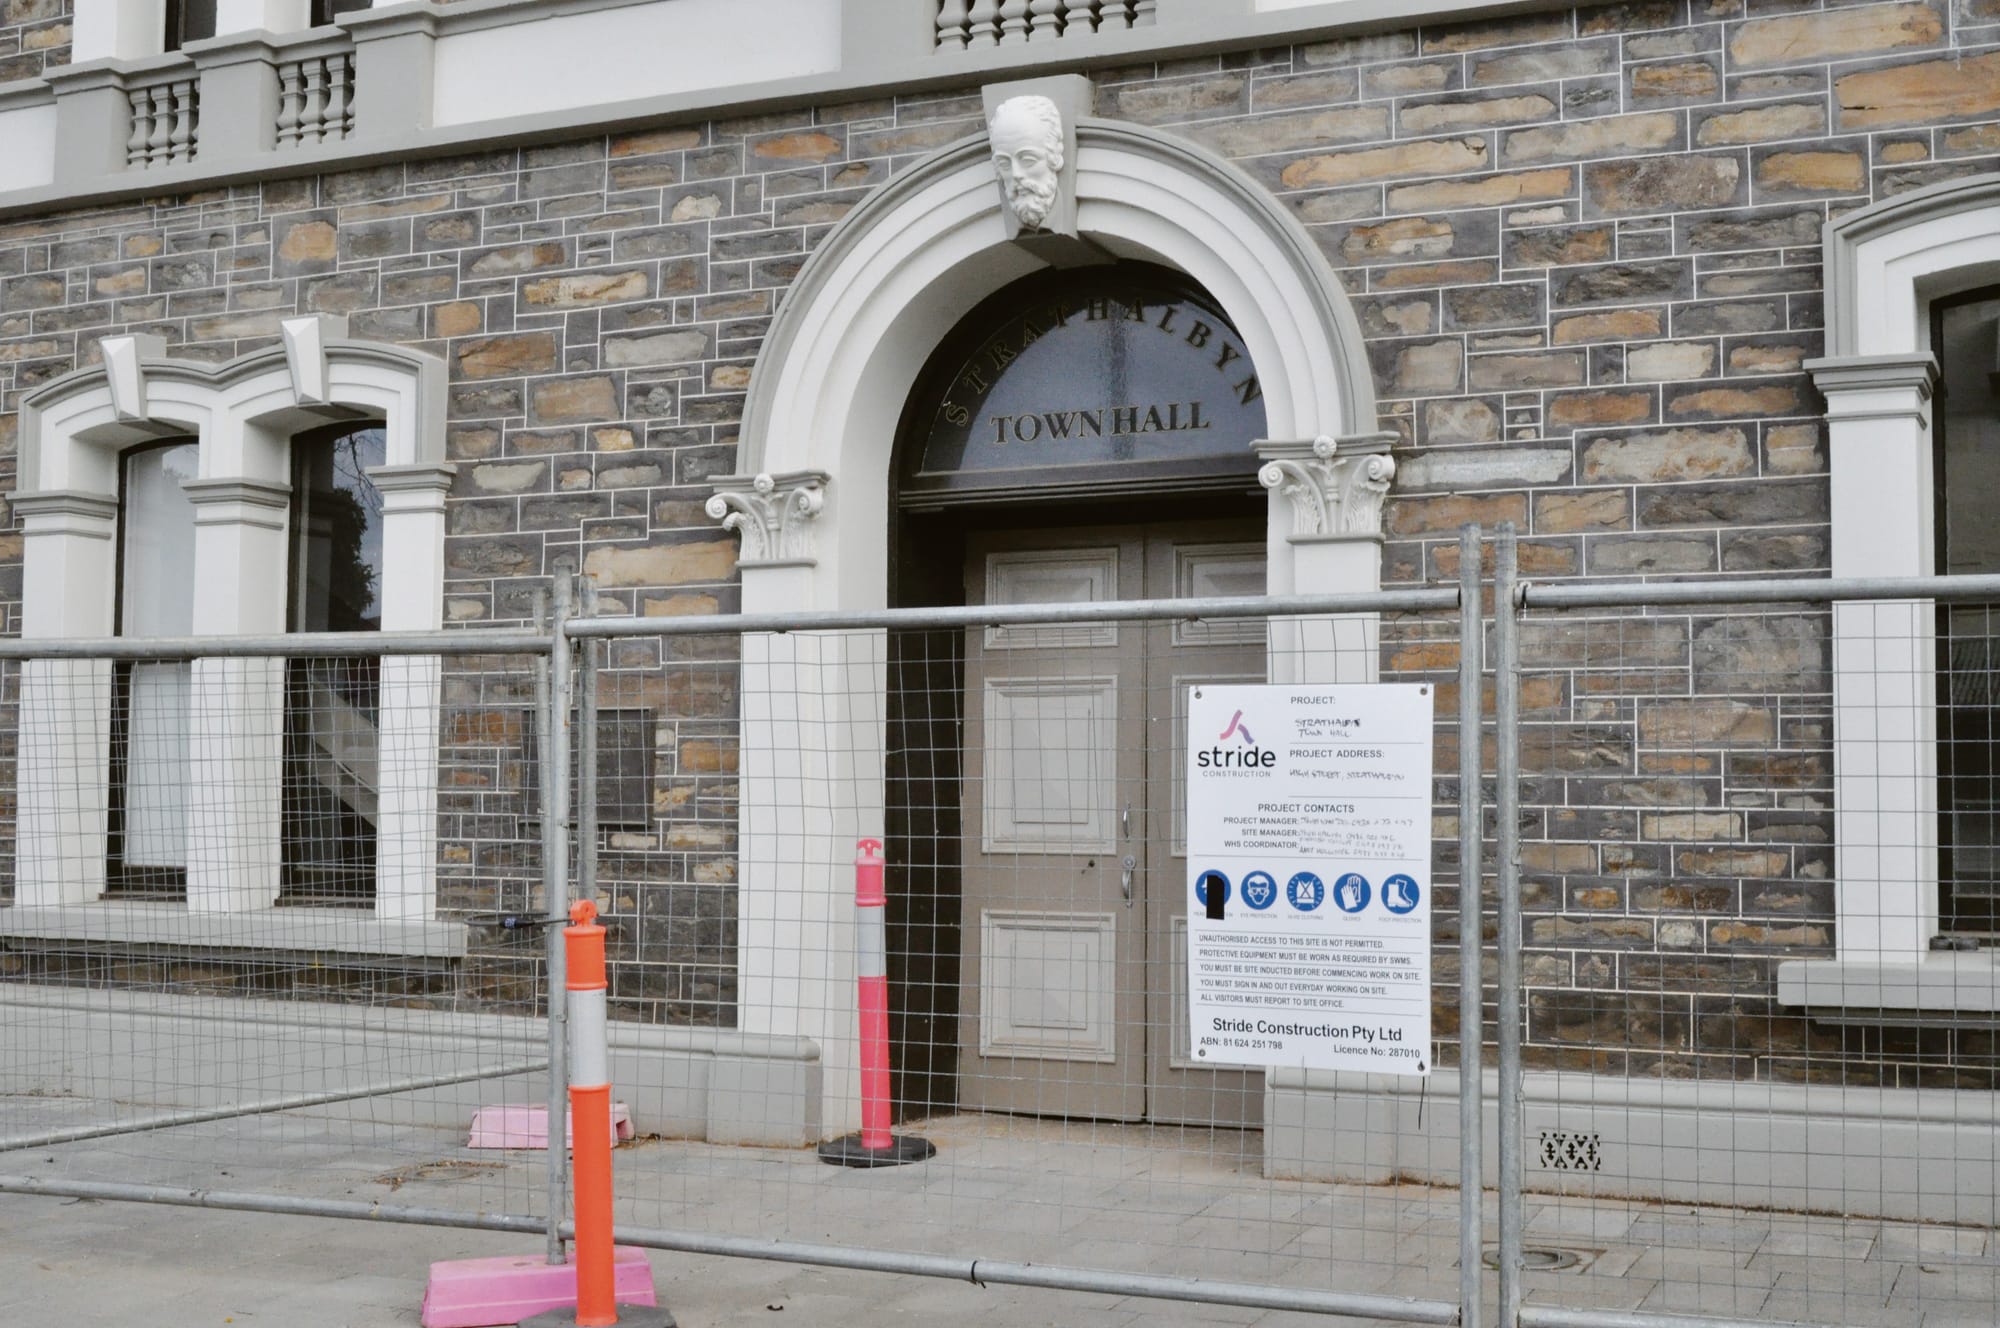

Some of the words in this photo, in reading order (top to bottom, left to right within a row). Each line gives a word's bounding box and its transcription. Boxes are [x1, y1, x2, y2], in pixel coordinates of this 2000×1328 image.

[945, 296, 1262, 427] STRATHALBYN
[991, 409, 1102, 444] TOWN
[1111, 402, 1210, 435] HALL
[1290, 696, 1336, 704] PROJECT:
[1197, 746, 1276, 768] stride
[1290, 750, 1332, 758] PROJECT
[1336, 750, 1385, 758] ADDRESS:
[1258, 804, 1301, 812] PROJECT
[1304, 804, 1355, 813] CONTACTS
[1243, 840, 1299, 849] COORDINATOR:
[1199, 935, 1248, 944] UNAUTHORISED
[1250, 937, 1276, 945] ACCESS
[1329, 939, 1343, 947] NOT
[1344, 940, 1384, 949] PERMITTED.
[1199, 949, 1238, 958] PROTECTIVE
[1240, 951, 1277, 960] EQUIPMENT
[1309, 953, 1330, 961] WORN
[1342, 954, 1377, 963] REQUIRED
[1378, 955, 1388, 964] BY
[1390, 956, 1412, 965] SWMS.
[1244, 966, 1259, 974] SITE
[1260, 966, 1292, 975] INDUCTED
[1294, 968, 1320, 976] BEFORE
[1322, 968, 1367, 978] COMMENCING
[1369, 970, 1390, 979] WORK
[1392, 972, 1403, 980] ON
[1404, 972, 1421, 981] SITE.
[1290, 983, 1324, 992] EVERYDAY
[1326, 984, 1358, 994] WORKING
[1360, 986, 1370, 994] ON
[1371, 986, 1387, 995] SITE.
[1215, 994, 1243, 1003] VISITORS
[1245, 996, 1262, 1004] MUST
[1264, 996, 1290, 1005] REPORT
[1319, 999, 1344, 1008] OFFICE.
[1213, 1018, 1253, 1033] Stride
[1257, 1020, 1349, 1039] Construction
[1352, 1025, 1375, 1043] Pty
[1379, 1027, 1402, 1041] Ltd
[1200, 1037, 1222, 1046] ABN:
[1252, 1040, 1265, 1049] 251
[1266, 1041, 1283, 1050] 798
[1334, 1045, 1368, 1055] Licence
[1370, 1047, 1386, 1056] No:
[1389, 1048, 1420, 1058] 287010
